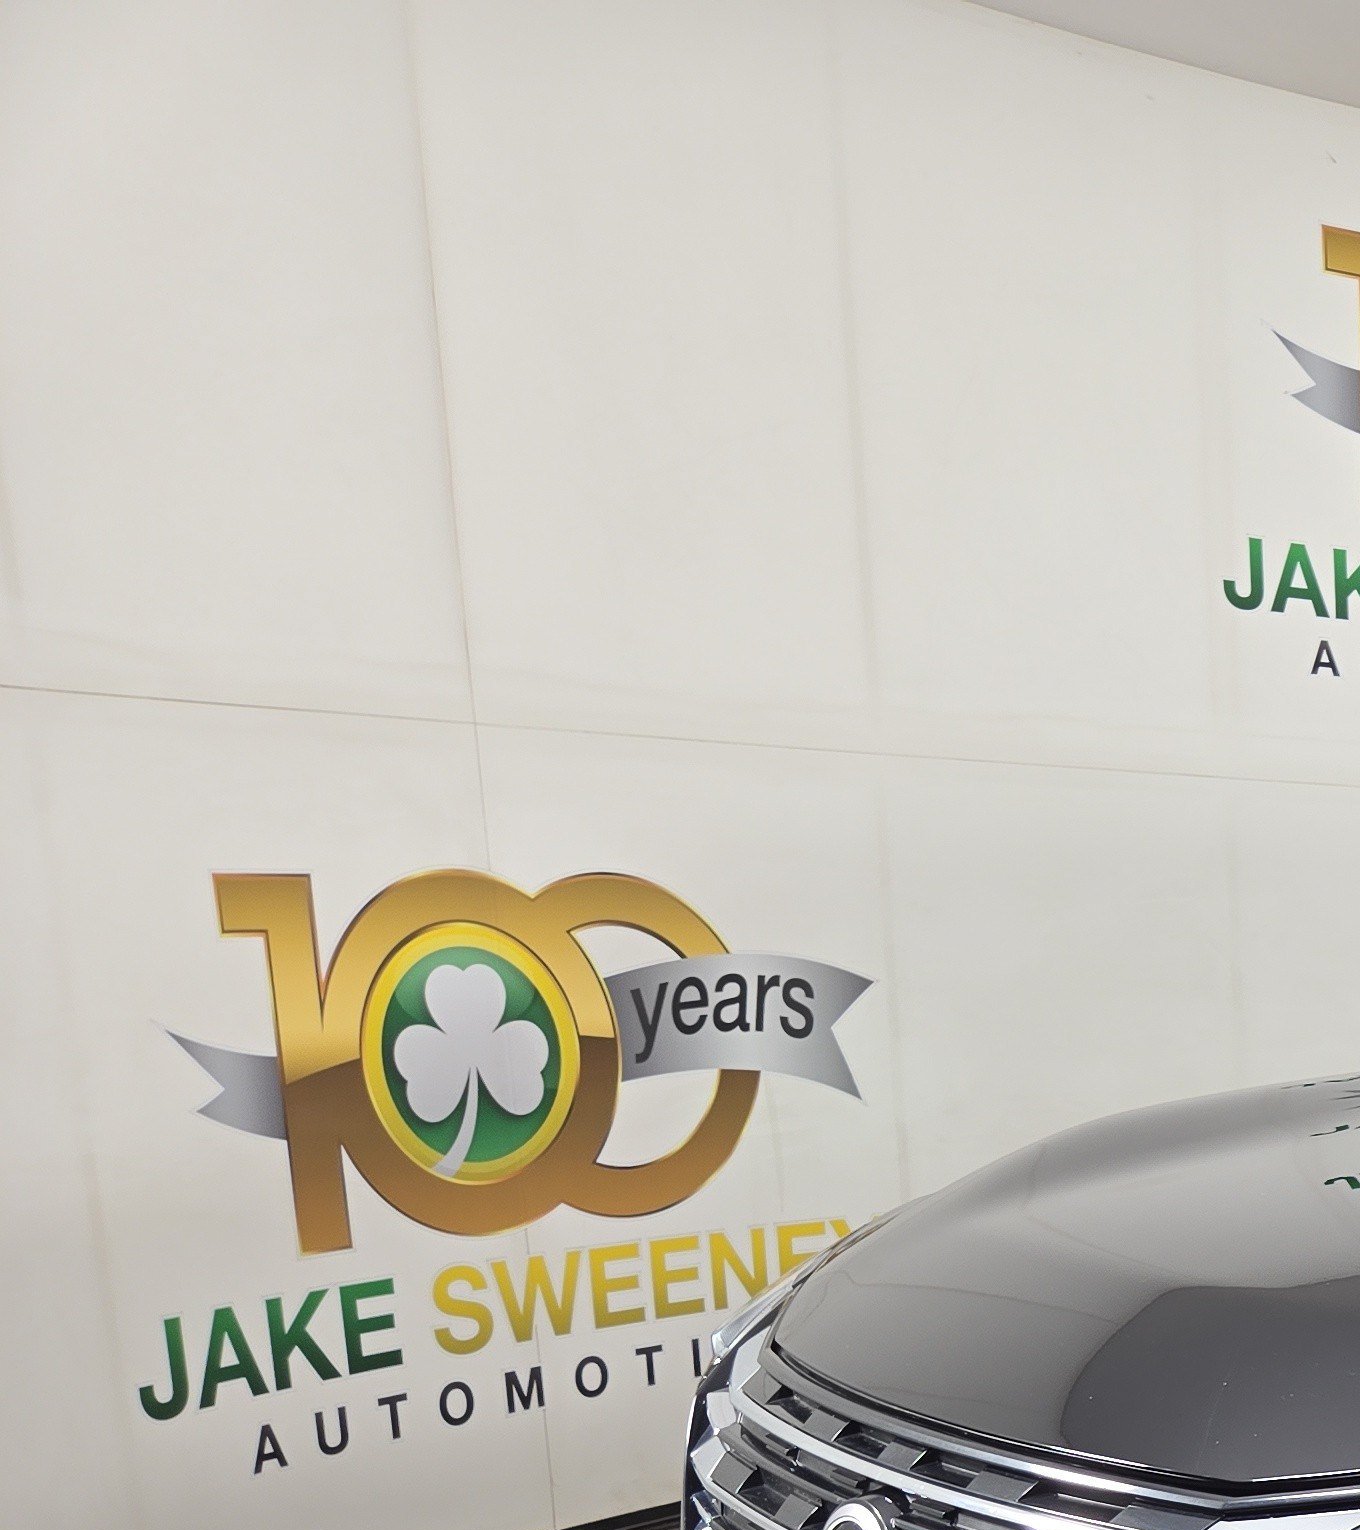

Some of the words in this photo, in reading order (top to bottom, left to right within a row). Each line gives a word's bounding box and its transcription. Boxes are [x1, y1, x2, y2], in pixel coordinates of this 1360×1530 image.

[212, 869, 760, 1256] 100
[632, 970, 814, 1063] years
[138, 1278, 402, 1422] JAKE
[252, 1338, 703, 1474] AUTOMOTI
